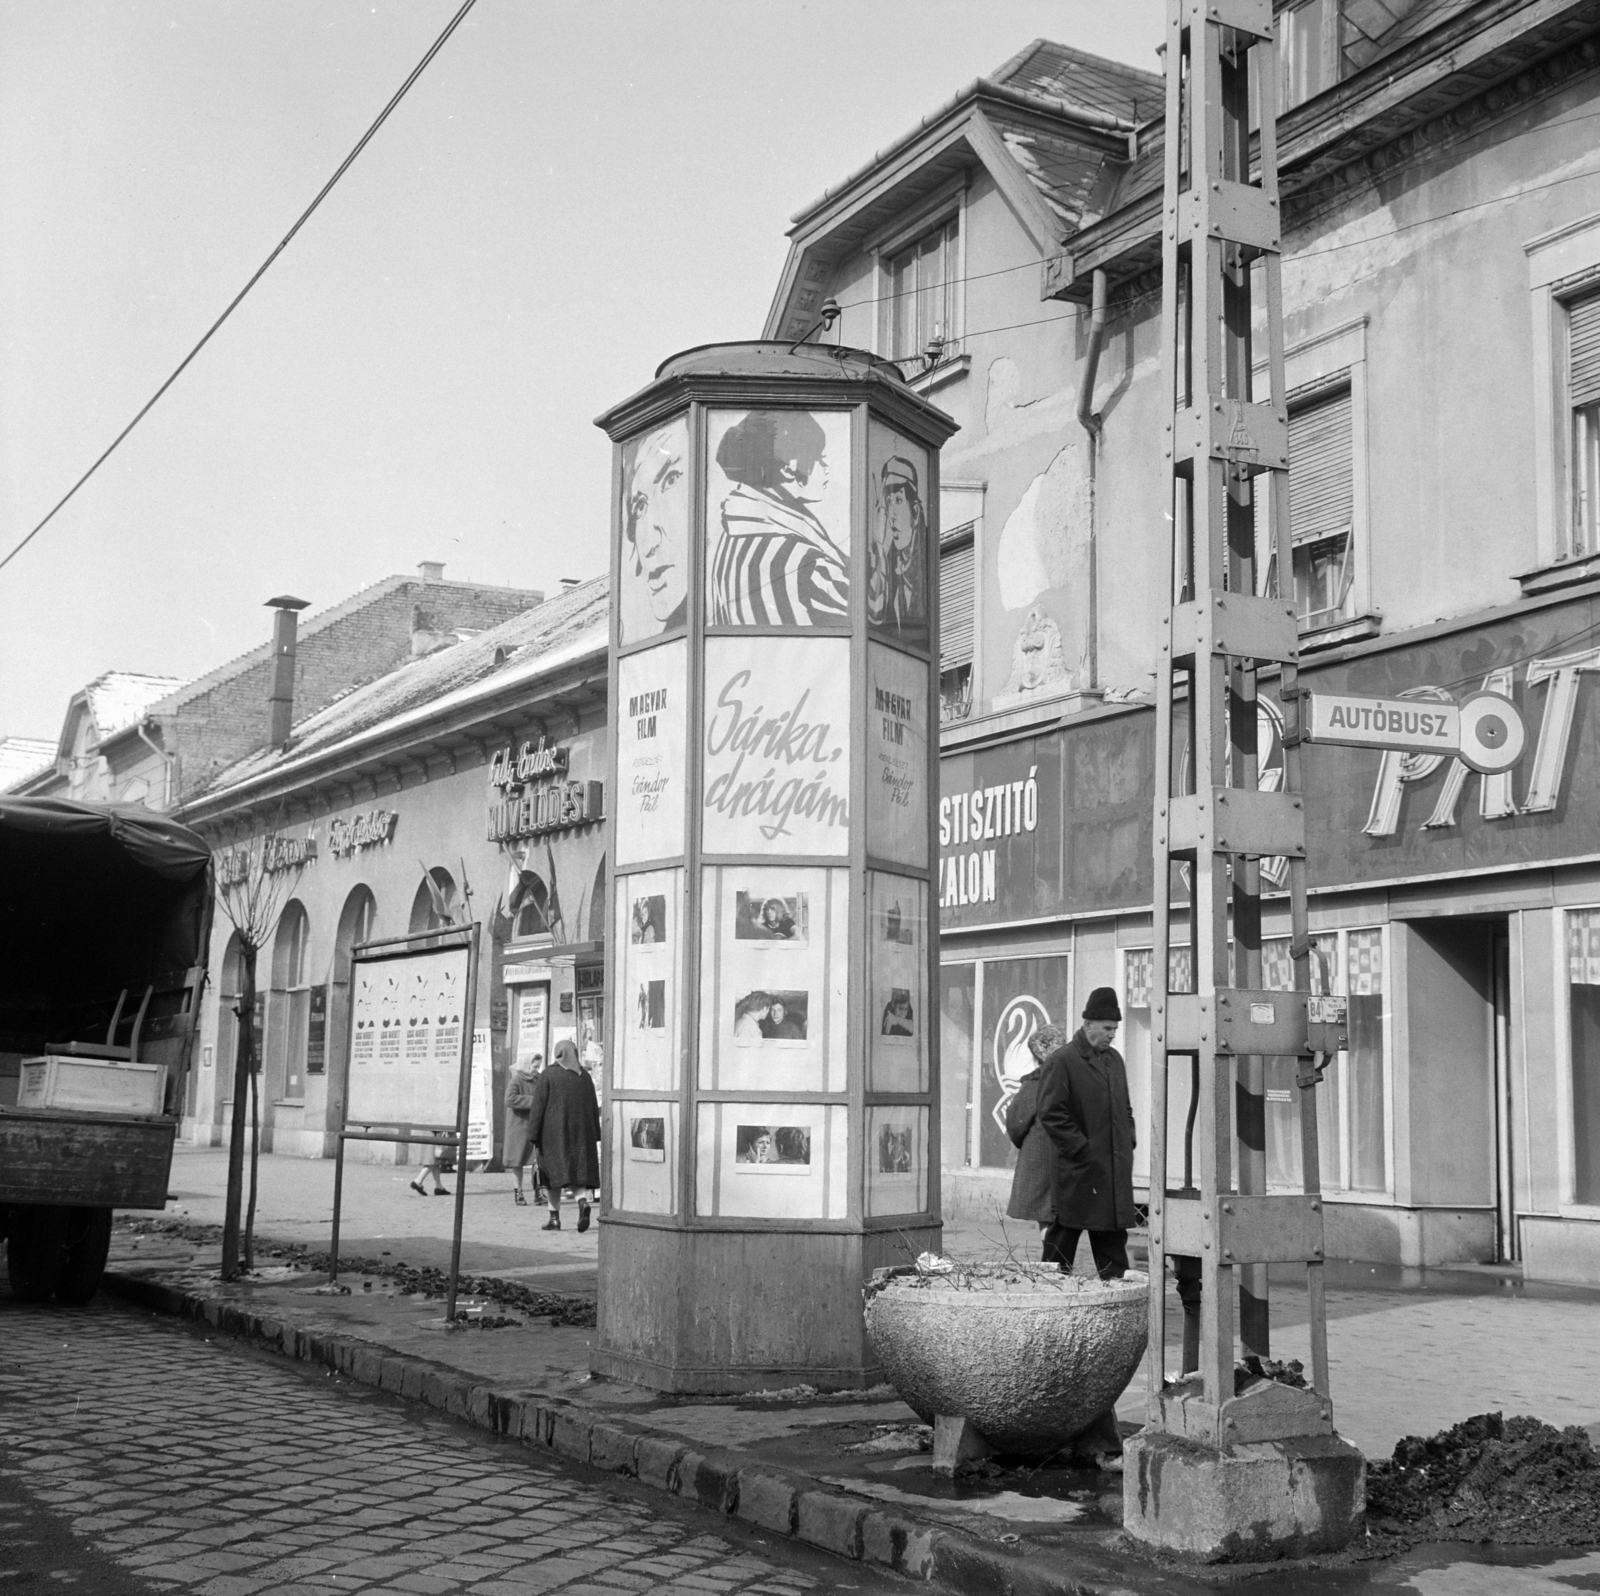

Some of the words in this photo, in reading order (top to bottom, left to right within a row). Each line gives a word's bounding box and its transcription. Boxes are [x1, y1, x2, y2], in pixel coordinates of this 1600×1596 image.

[629, 688, 667, 717] MAGYAR
[875, 687, 912, 721] MAGYAR
[637, 715, 657, 740] FILM
[707, 669, 842, 764] Sárika,
[1329, 702, 1448, 737] AUTÓBUSZ
[882, 717, 904, 746] FILM
[632, 770, 670, 796] Sándor
[882, 766, 914, 791] Sándor
[640, 794, 660, 813] Pál
[705, 751, 850, 840] drágám
[891, 787, 909, 807] Pál
[1310, 1002, 1321, 1017] 84
